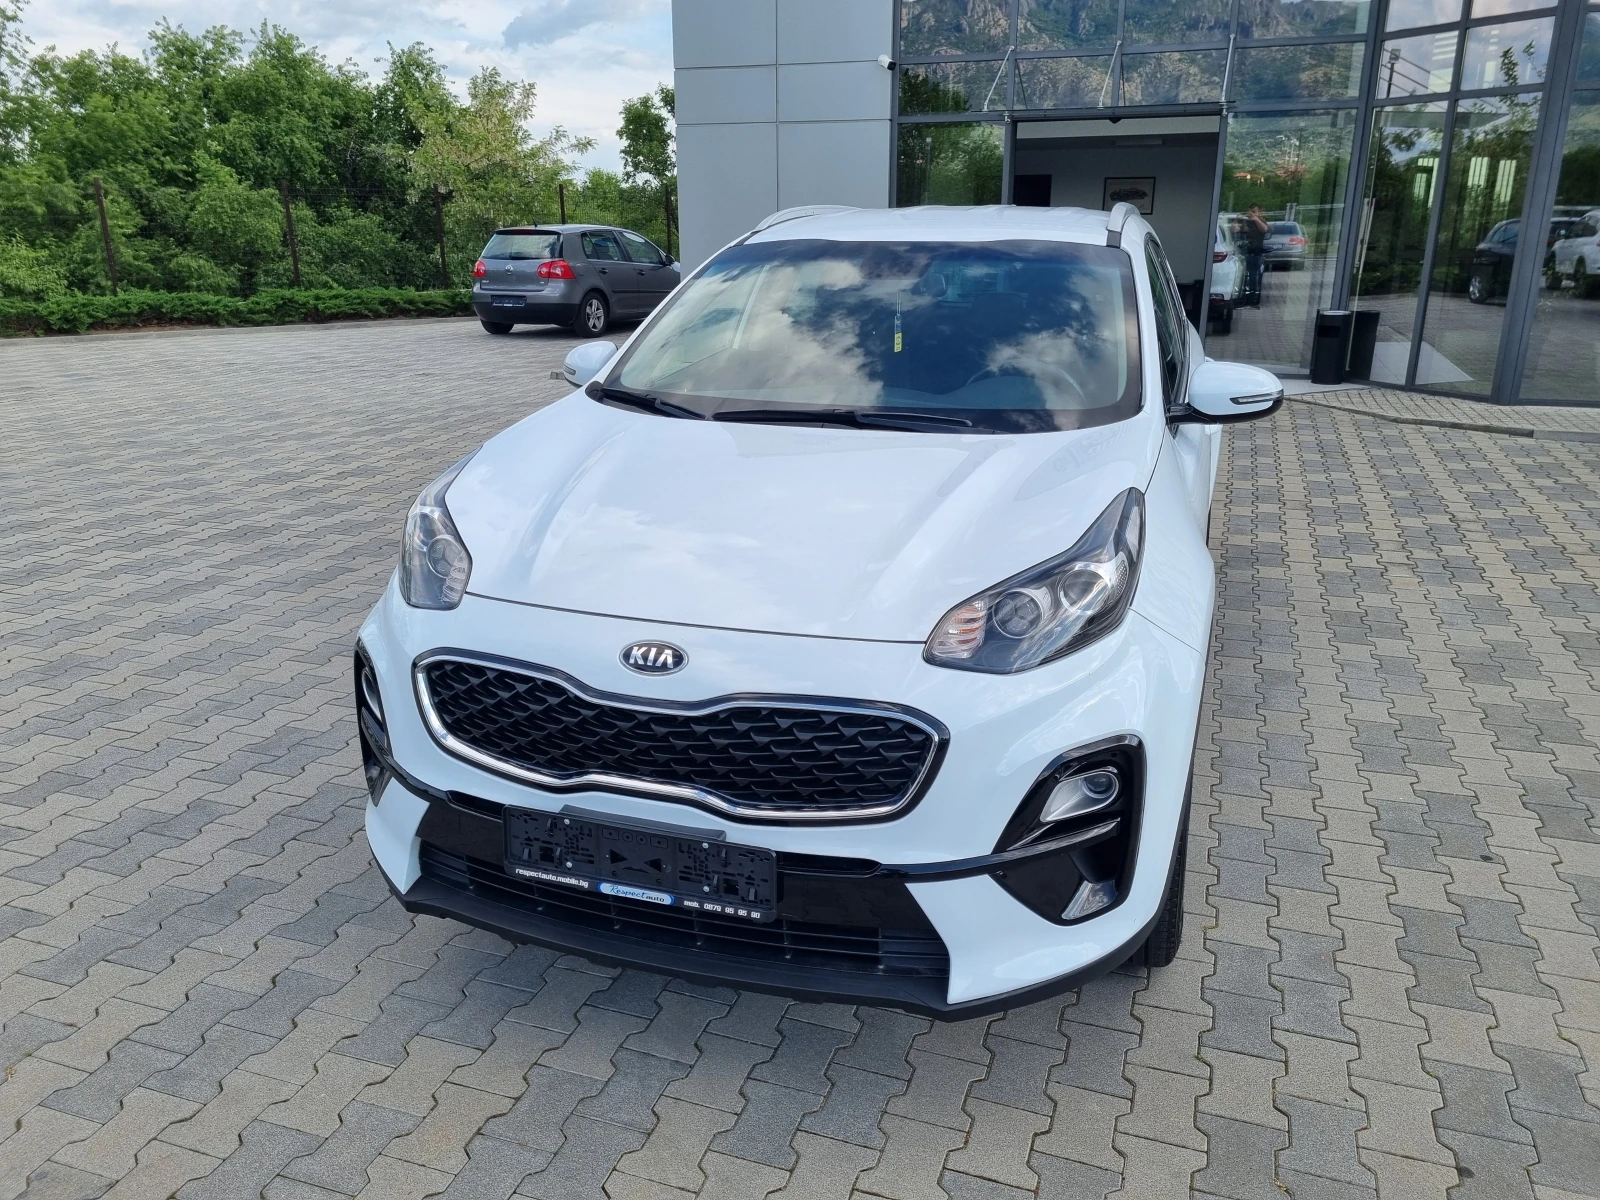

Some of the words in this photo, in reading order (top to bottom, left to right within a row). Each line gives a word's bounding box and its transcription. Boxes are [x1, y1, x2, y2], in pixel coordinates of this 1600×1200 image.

[628, 646, 674, 669] KIA
[515, 868, 589, 889] respectauto.mobile.bg
[683, 900, 700, 909] mob.
